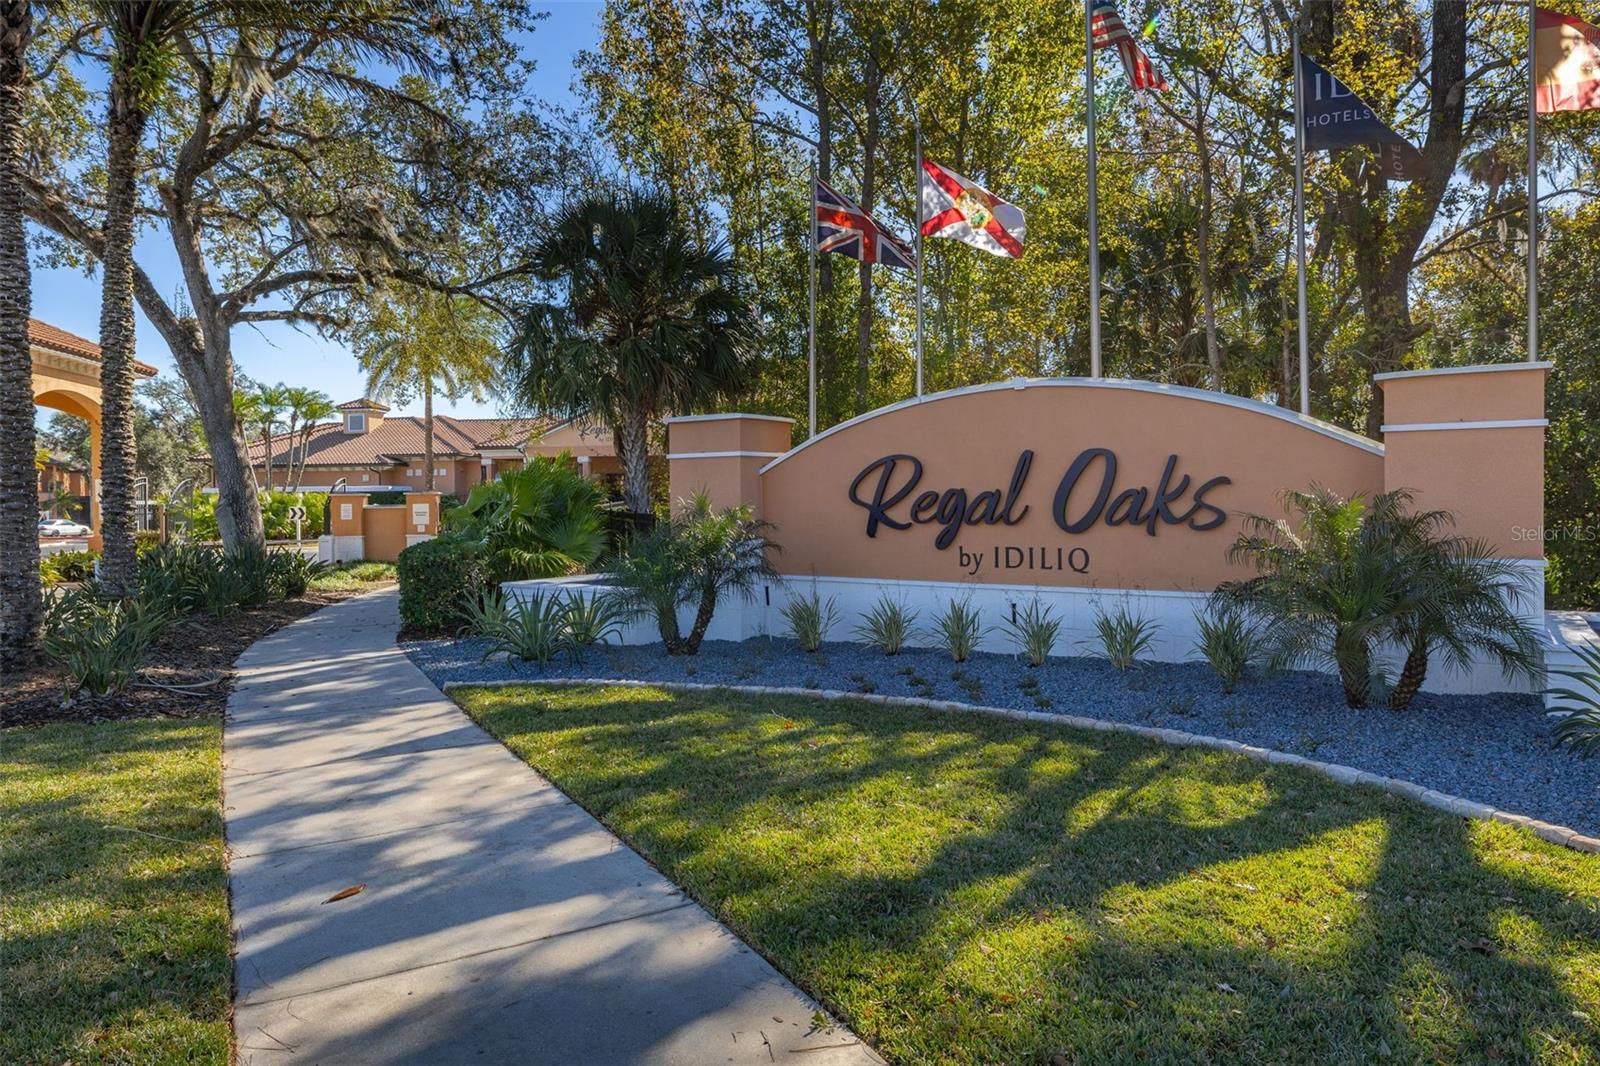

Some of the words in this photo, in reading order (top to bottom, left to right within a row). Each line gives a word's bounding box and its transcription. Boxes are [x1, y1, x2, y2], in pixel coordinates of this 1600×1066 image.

[1306, 109, 1371, 128] HOTELS
[848, 449, 1035, 551] Regal
[1052, 447, 1232, 537] Oaks
[958, 545, 983, 575] by
[993, 546, 1090, 574] IDILIQ
